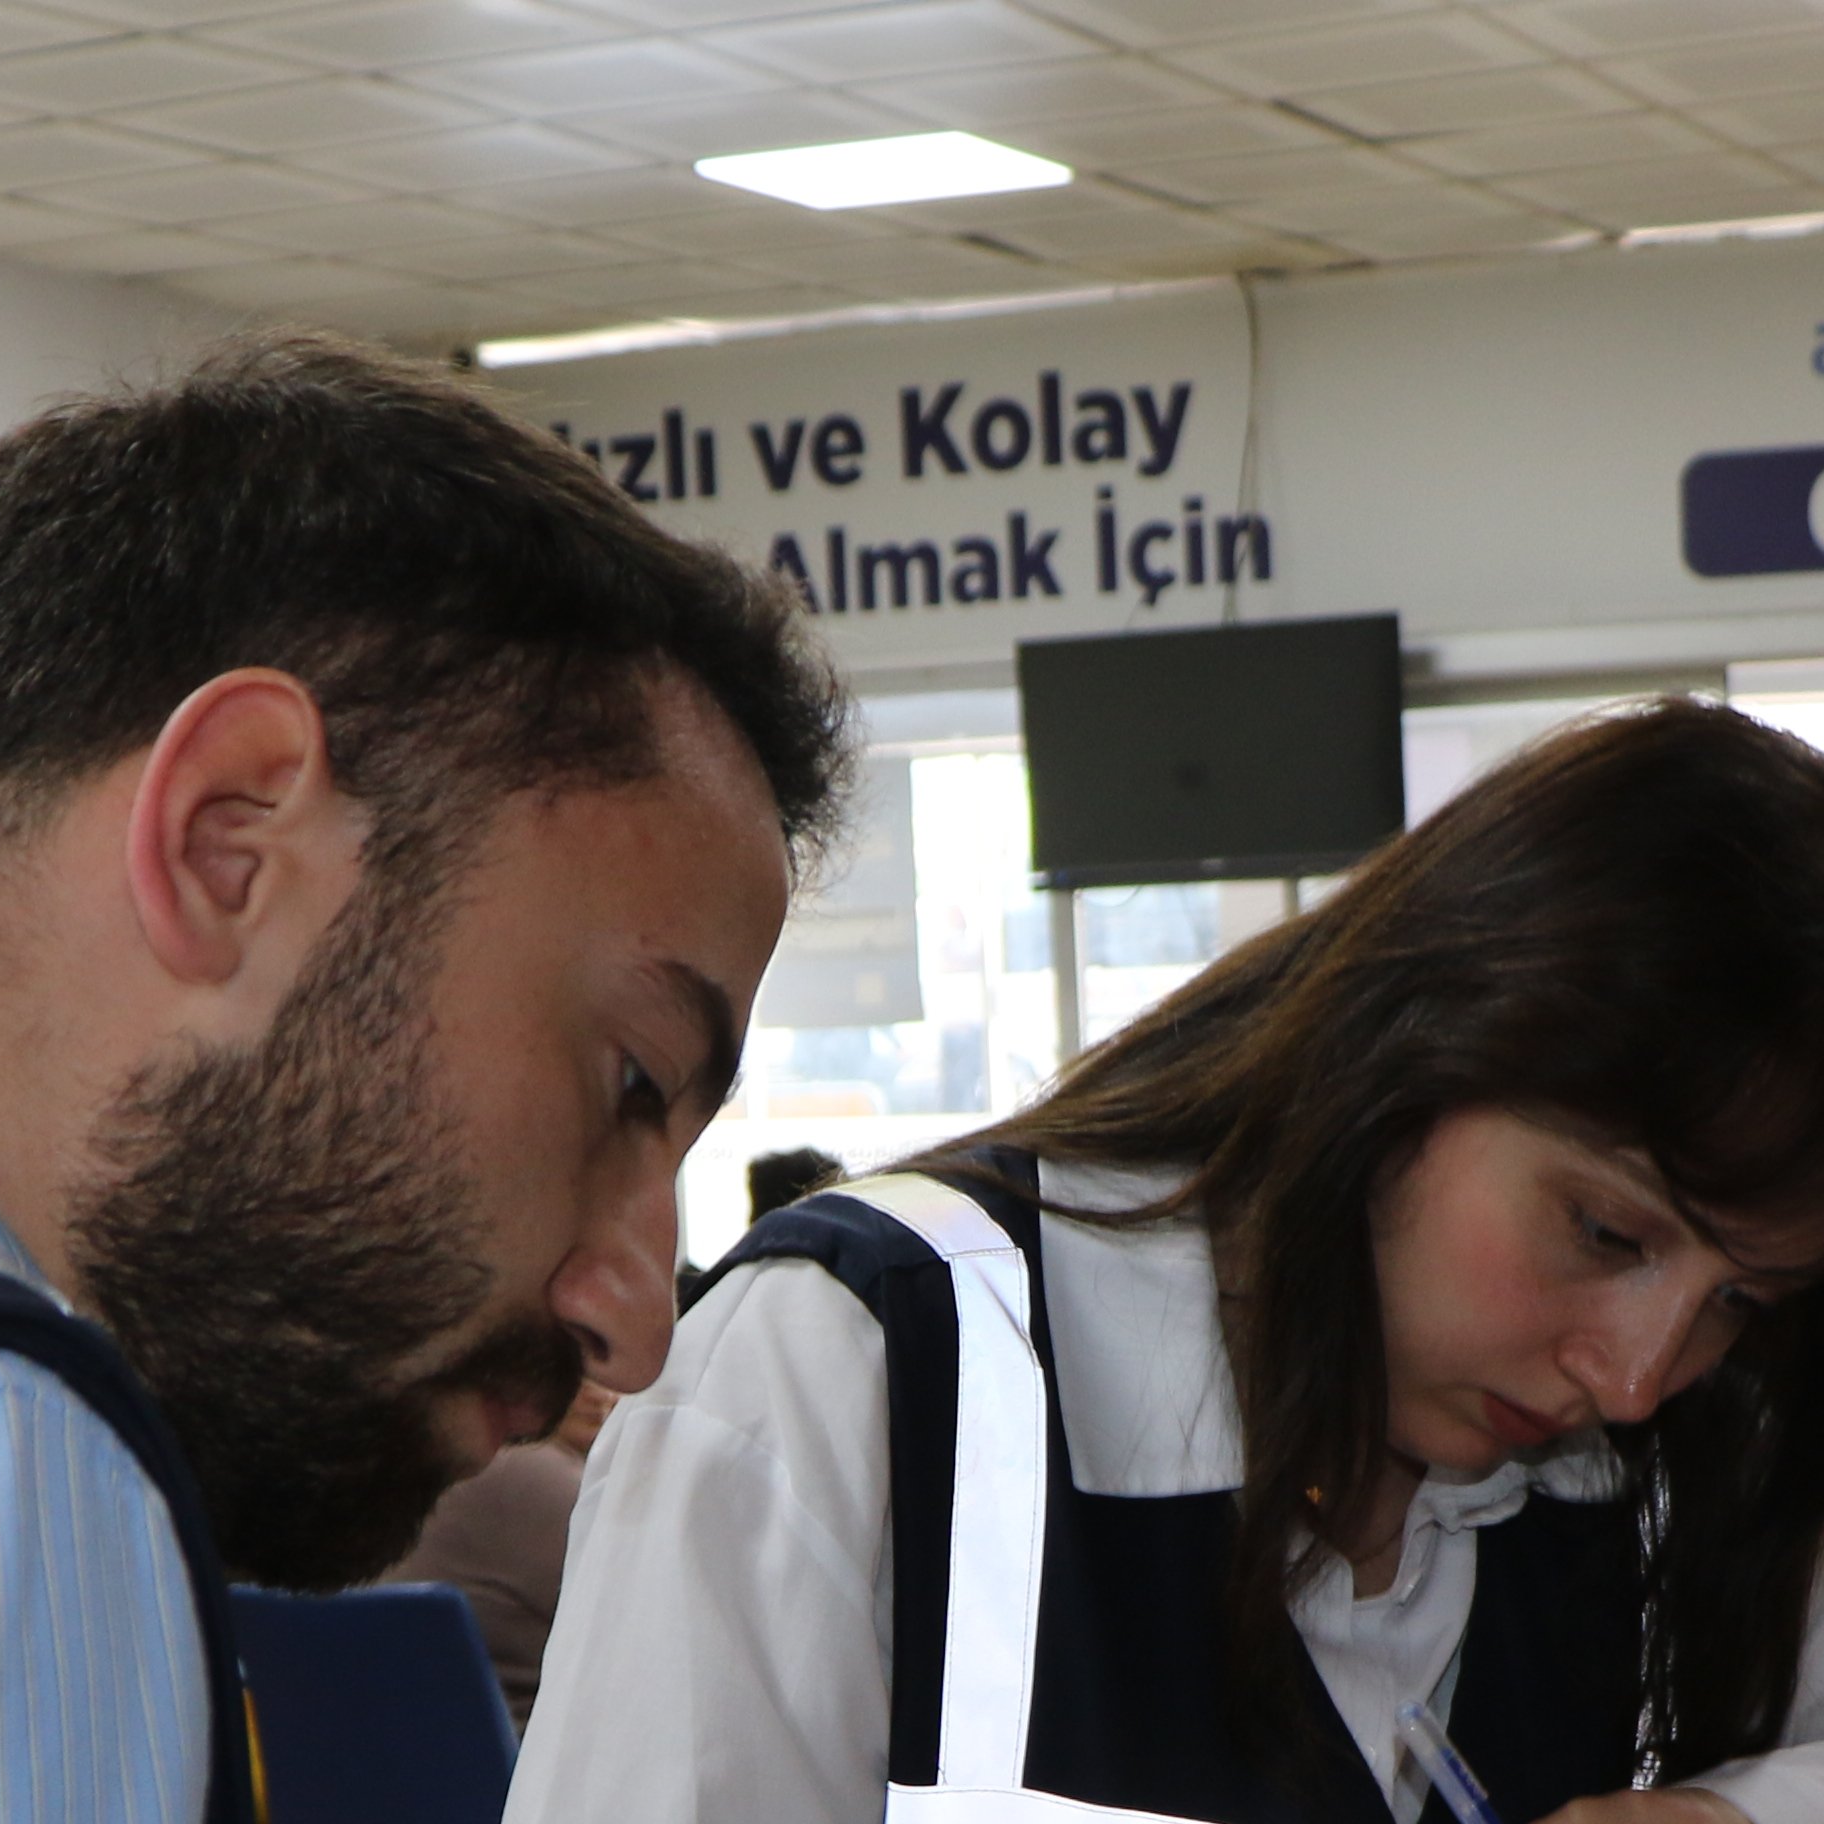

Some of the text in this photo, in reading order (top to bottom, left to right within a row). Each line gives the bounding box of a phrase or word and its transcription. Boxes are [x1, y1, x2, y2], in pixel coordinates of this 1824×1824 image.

[550, 368, 1192, 501] zlı ve Kolay
[770, 482, 1272, 614] Almak İçin
